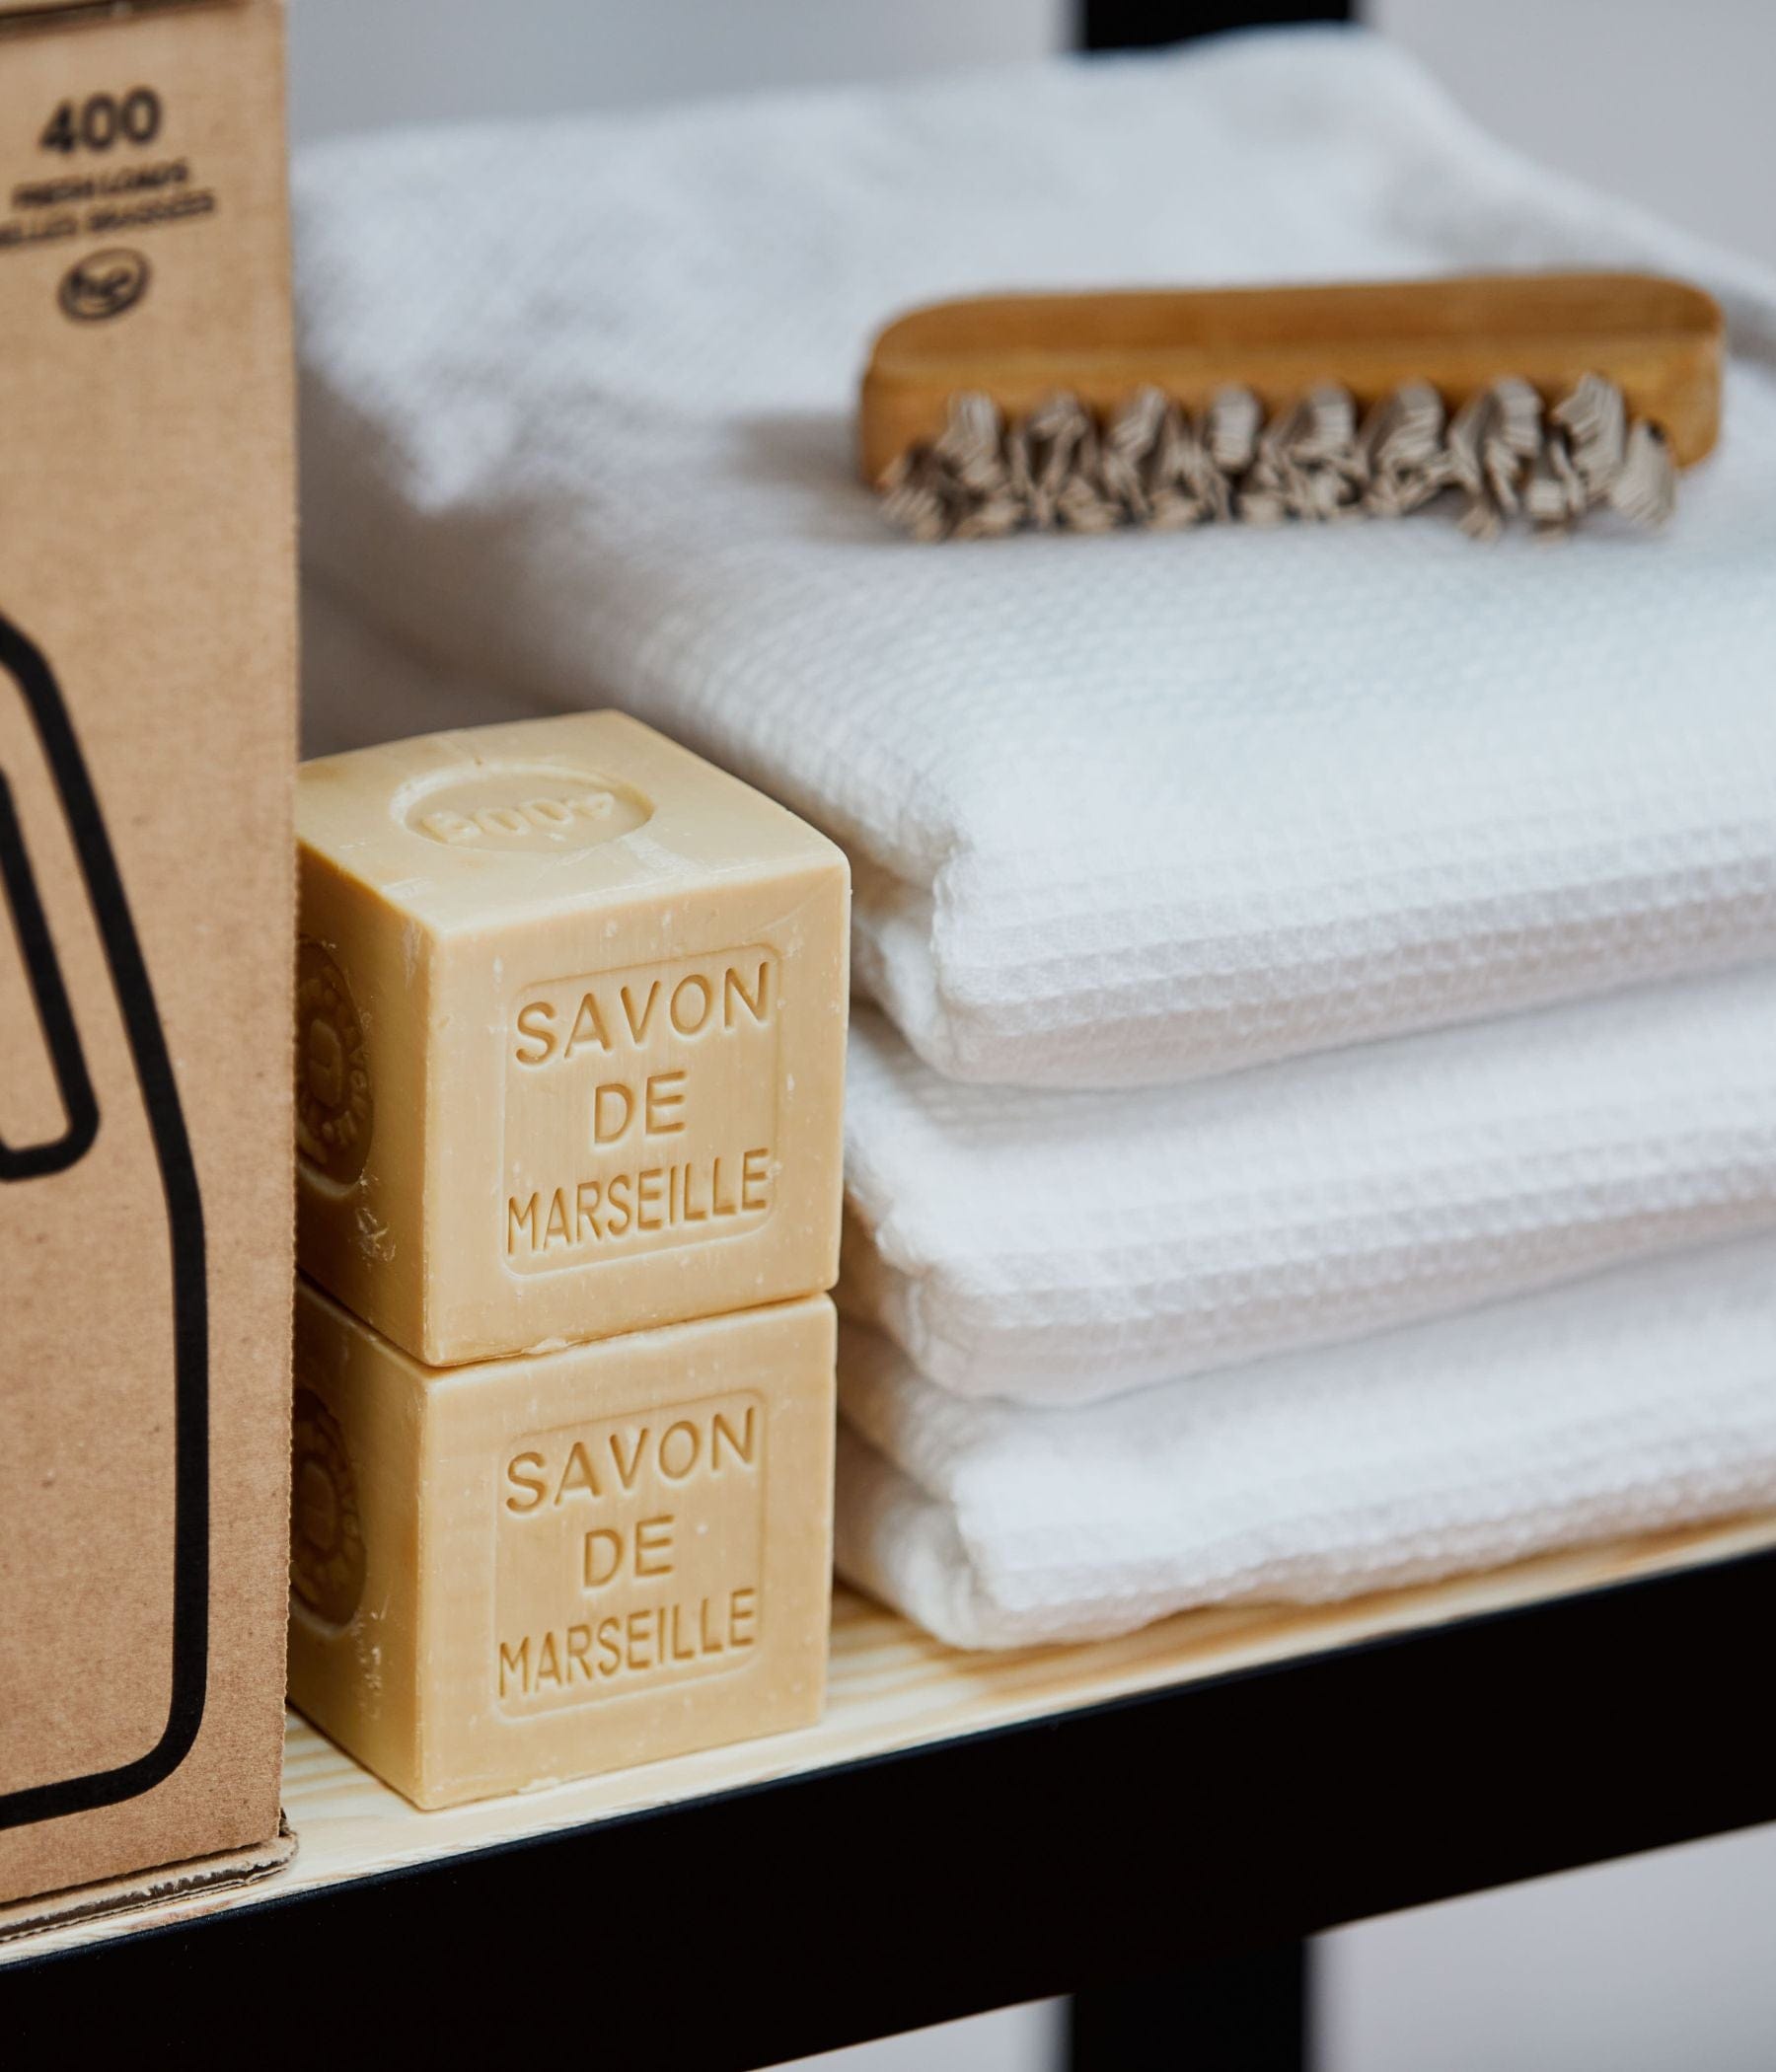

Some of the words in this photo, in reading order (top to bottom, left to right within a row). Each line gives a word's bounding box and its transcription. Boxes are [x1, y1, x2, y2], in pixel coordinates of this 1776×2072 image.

[39, 87, 162, 154] 400
[514, 961, 769, 1066] SAVON
[594, 1071, 685, 1145] DE
[506, 1147, 769, 1254] MARSEILLE
[505, 1406, 755, 1512] SAVON
[583, 1515, 675, 1588] DE
[498, 1587, 755, 1697] MARSEILLE
